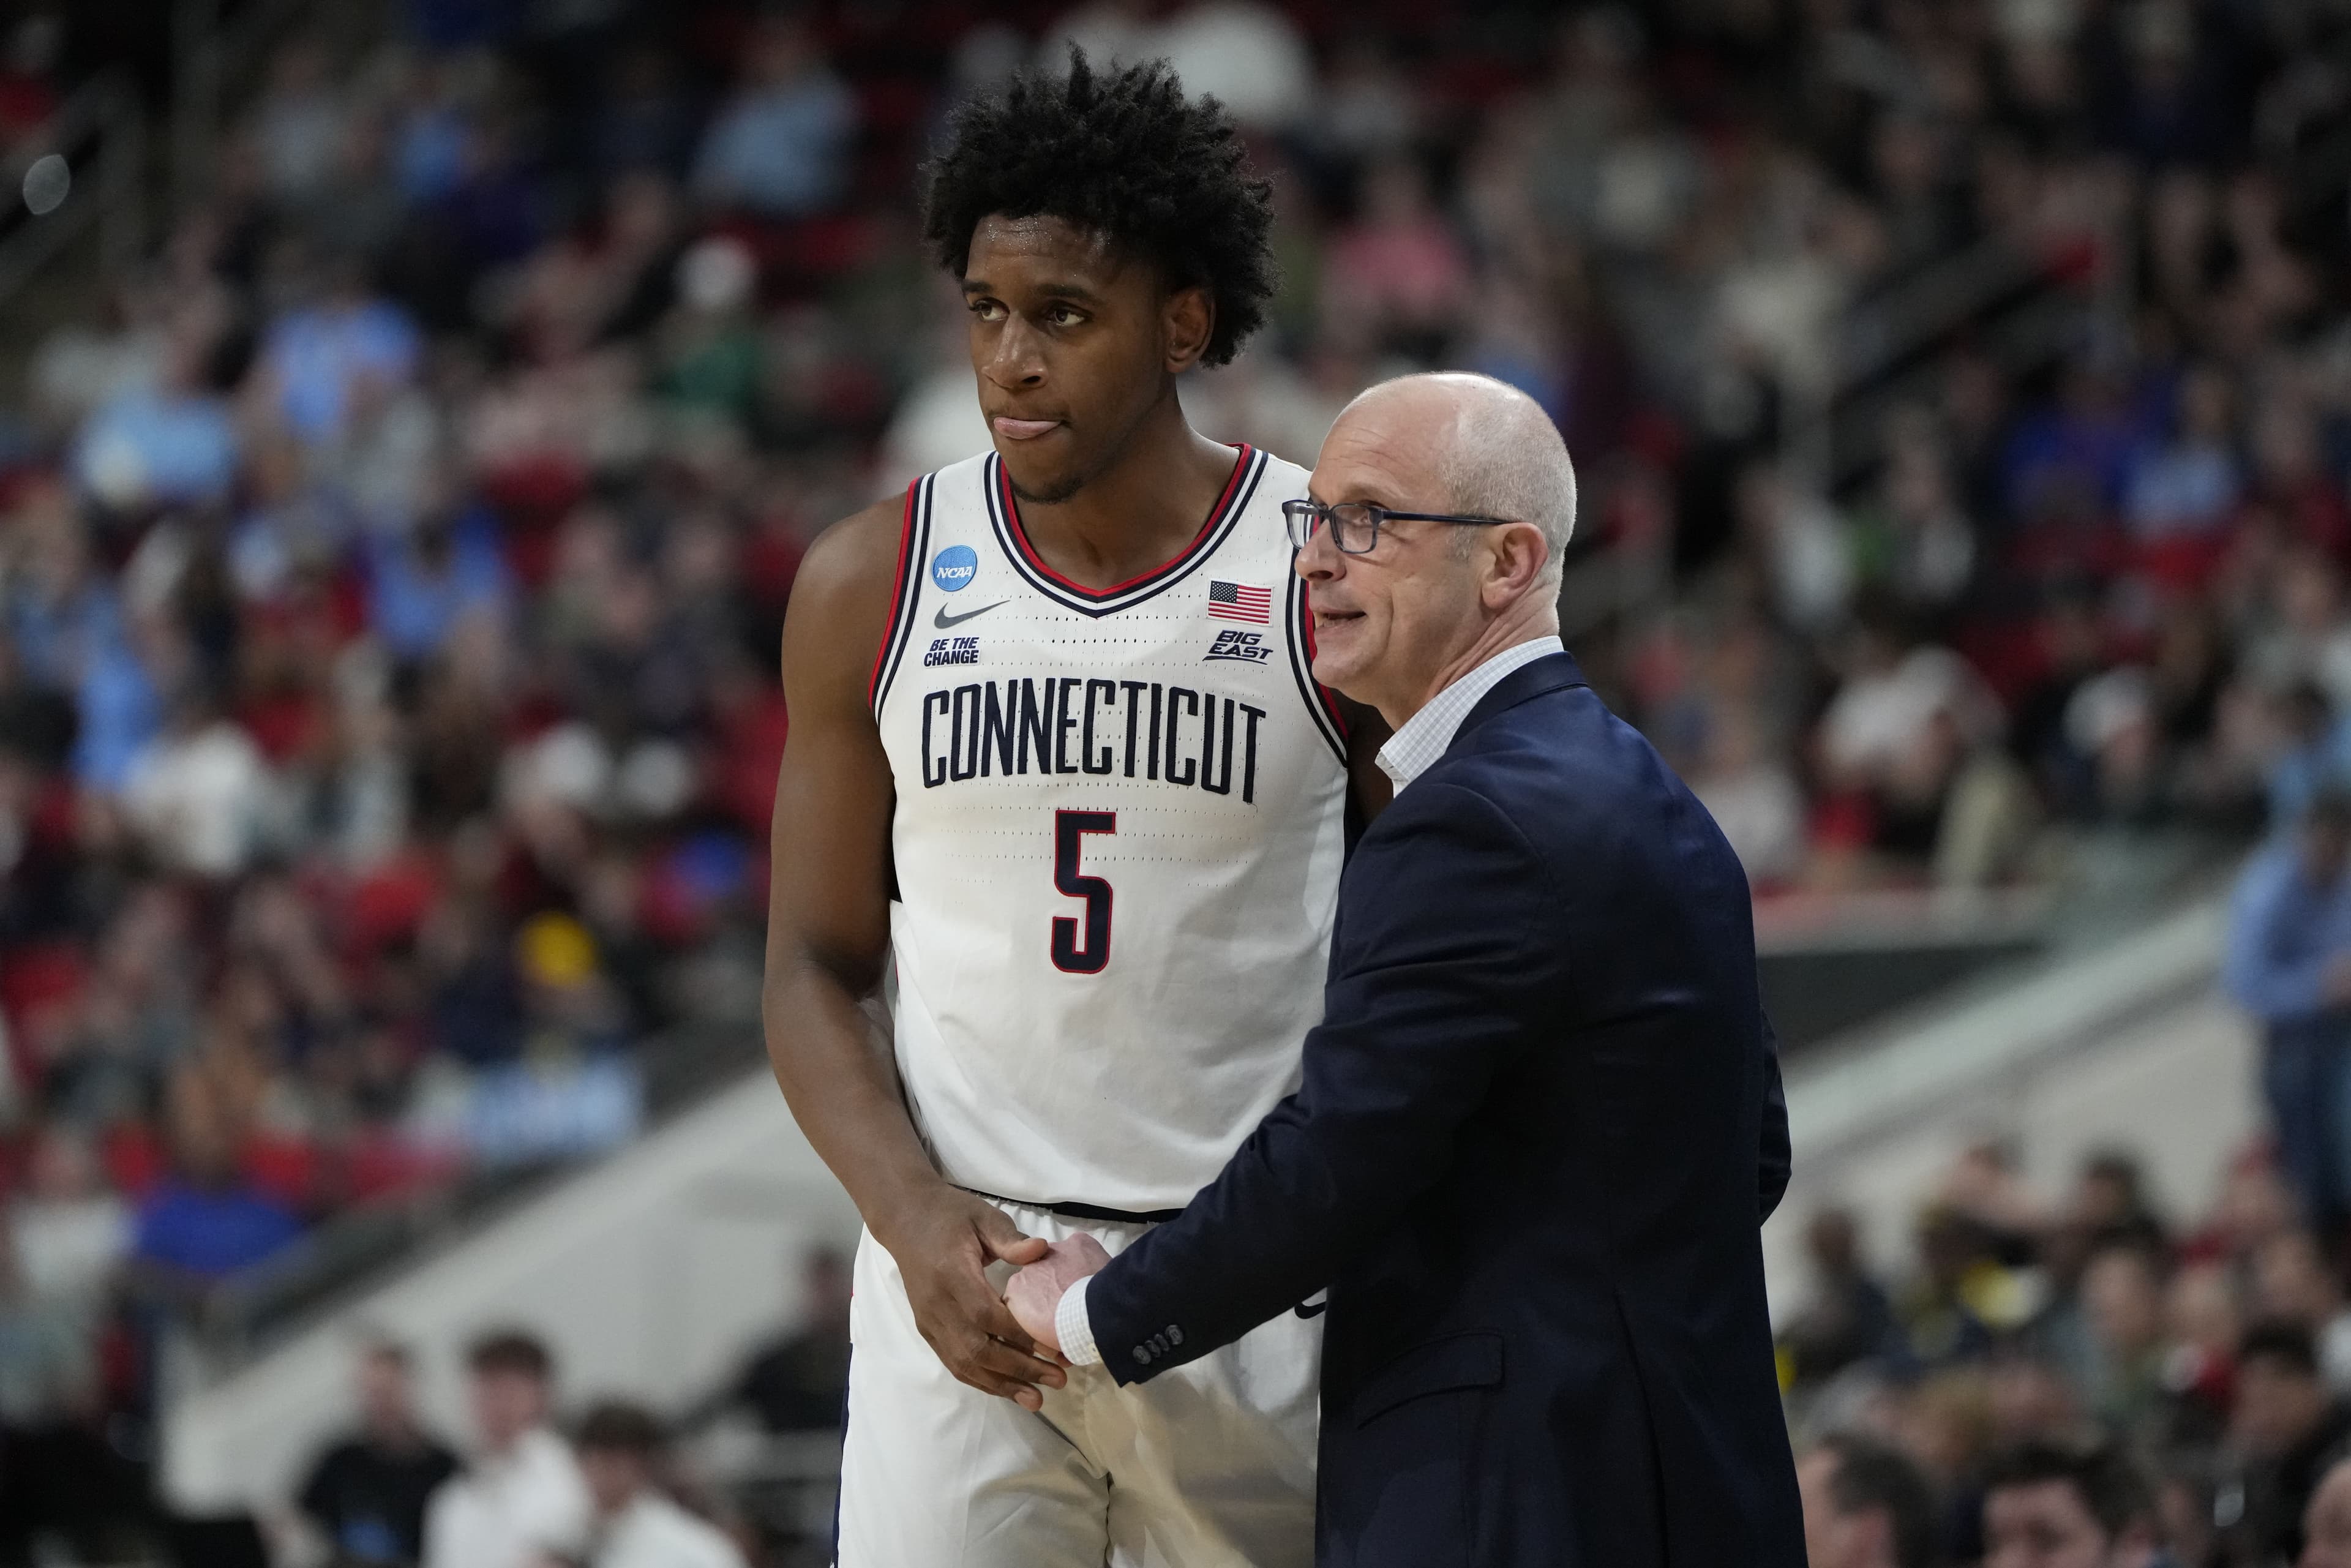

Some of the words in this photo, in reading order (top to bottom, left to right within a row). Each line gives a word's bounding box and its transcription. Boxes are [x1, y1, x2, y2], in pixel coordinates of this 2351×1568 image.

[937, 566, 972, 578] NCAA
[930, 639, 950, 651] BE
[953, 637, 980, 650] THE
[1216, 629, 1263, 645] BIG
[924, 650, 979, 667] CHANGE
[1208, 642, 1273, 659] EAST
[923, 678, 1266, 803] CONNECTICUT
[1051, 810, 1116, 974] 5
